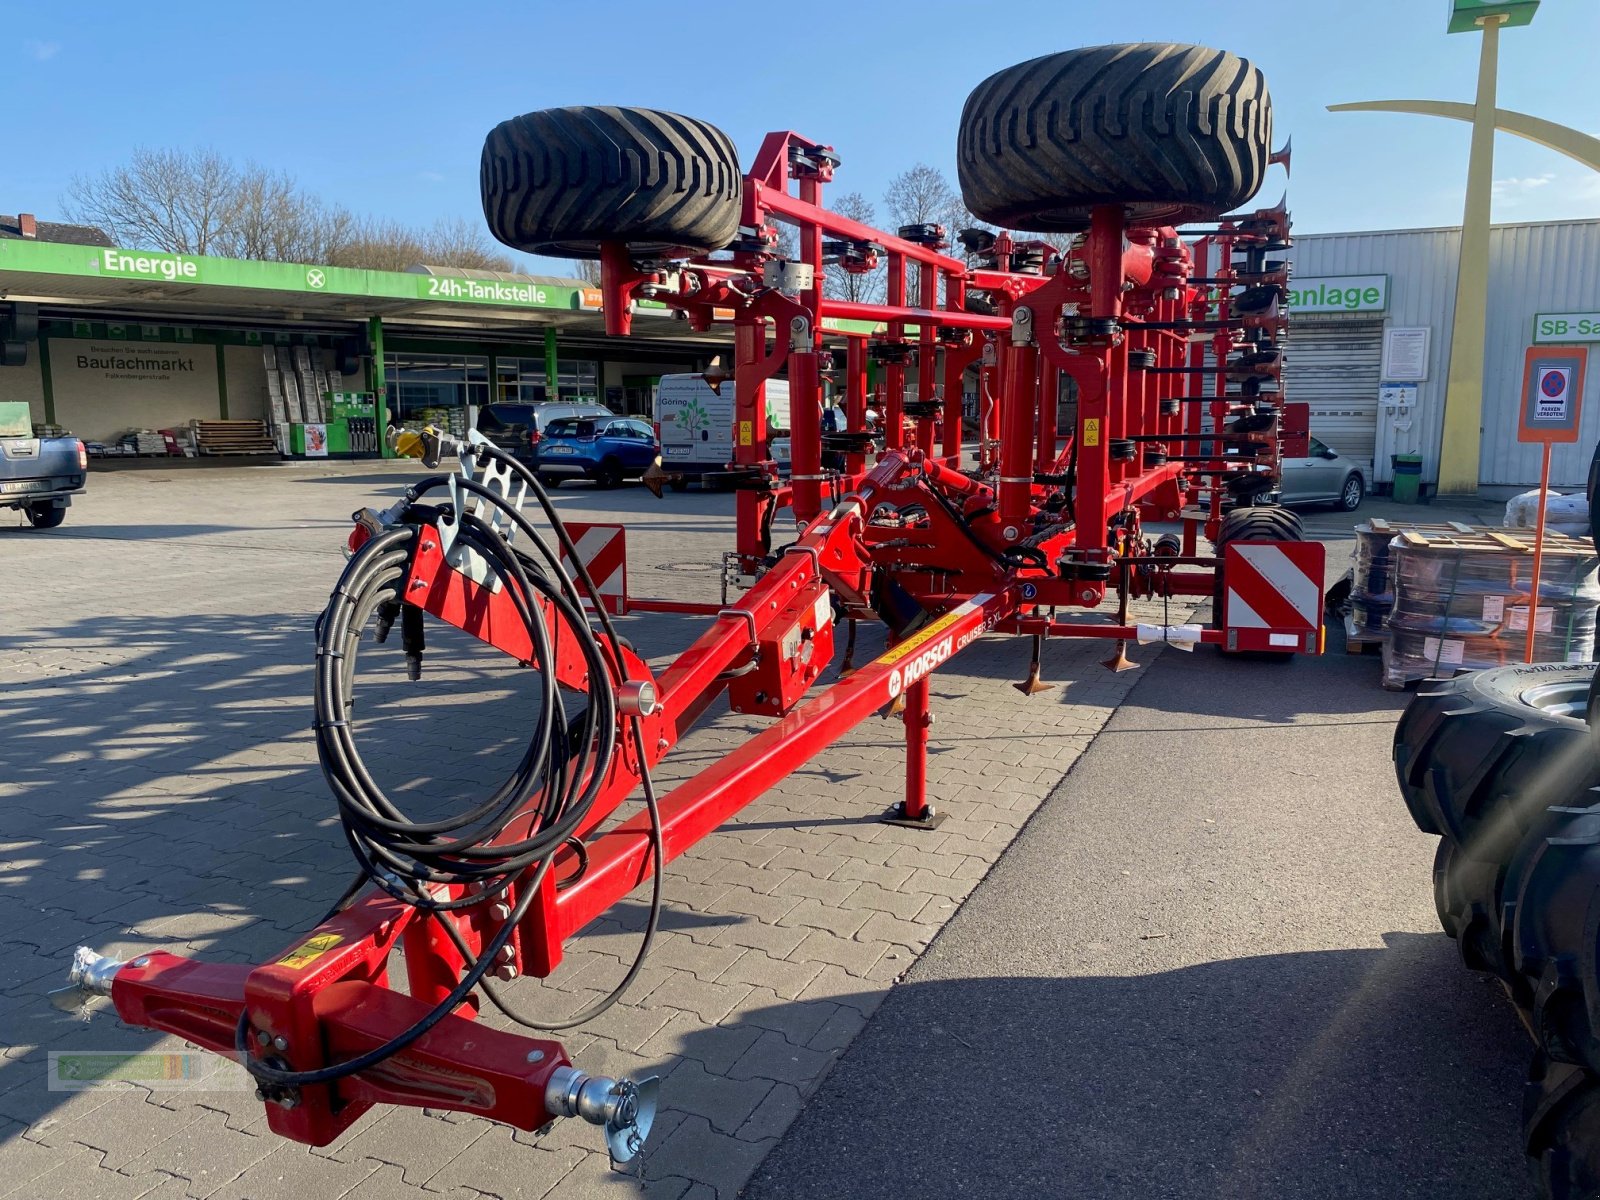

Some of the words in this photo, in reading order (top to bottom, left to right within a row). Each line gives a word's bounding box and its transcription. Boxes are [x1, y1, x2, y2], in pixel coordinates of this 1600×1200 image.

[103, 249, 198, 280] Energie
[428, 278, 547, 304] 24h-Tankstelle
[77, 355, 195, 372] Baufachmarkt
[903, 635, 953, 688] HORSCH
[957, 621, 987, 650] CRUISER
[993, 611, 1002, 626] XL
